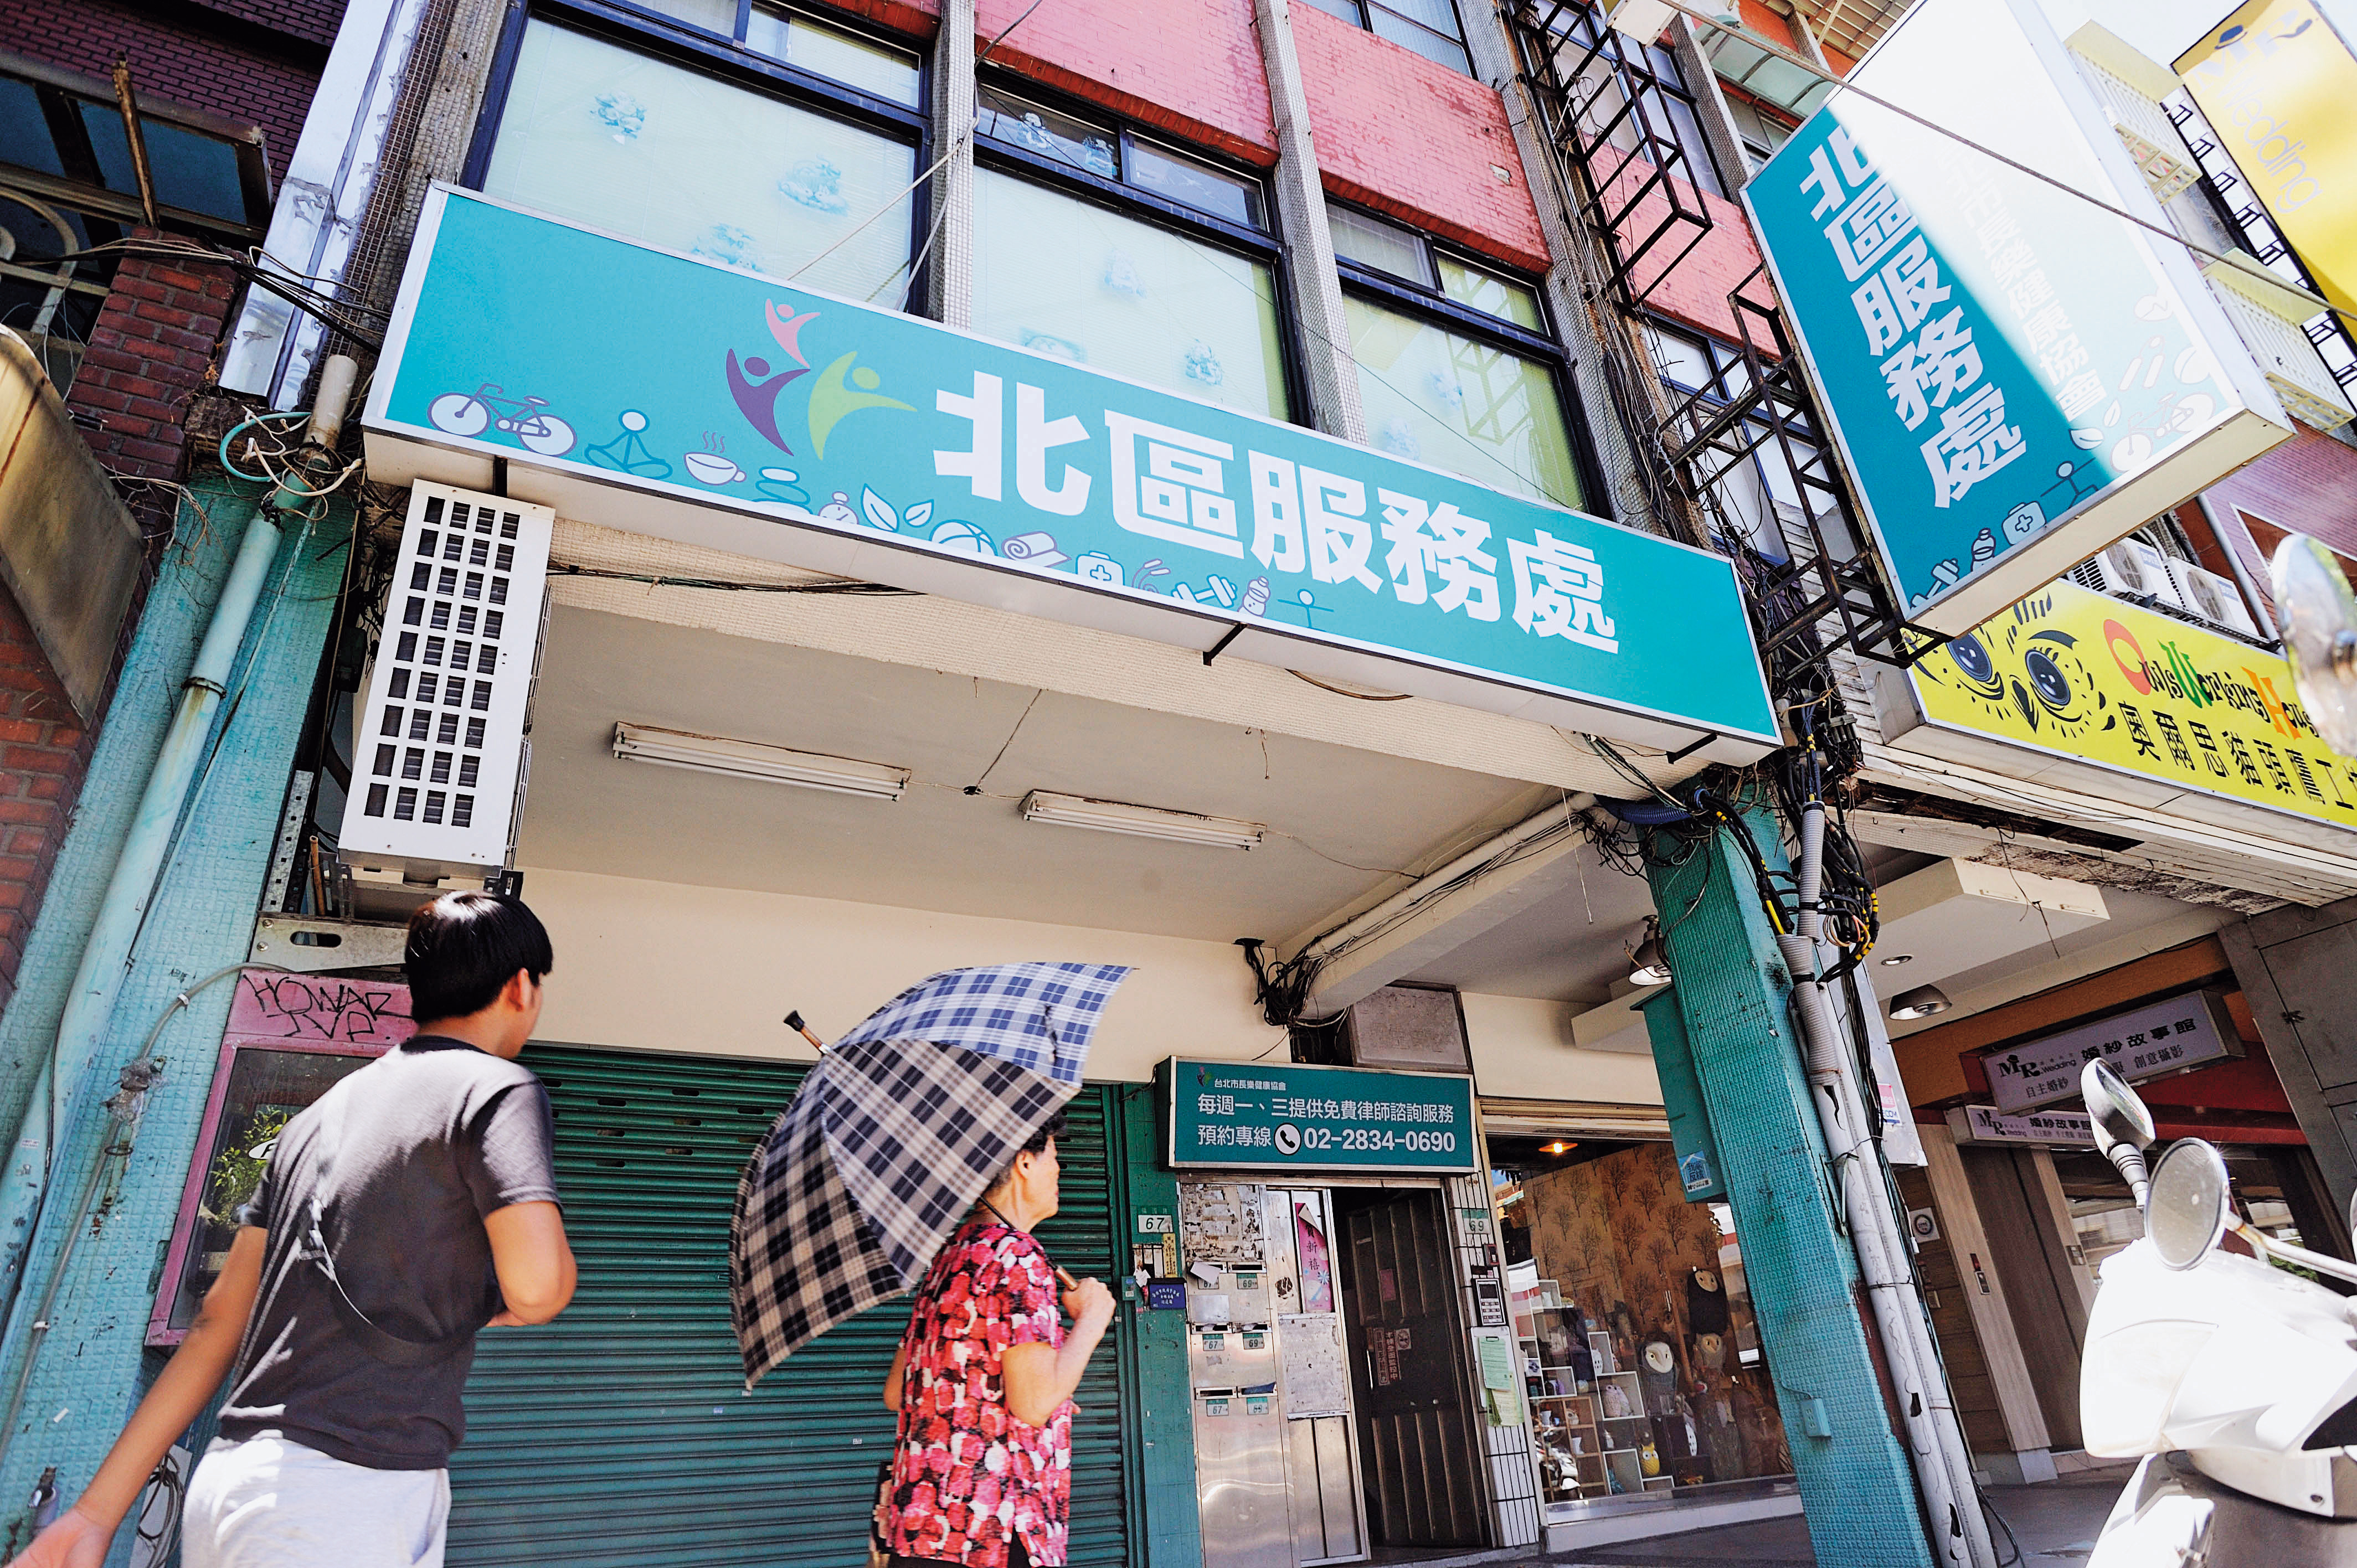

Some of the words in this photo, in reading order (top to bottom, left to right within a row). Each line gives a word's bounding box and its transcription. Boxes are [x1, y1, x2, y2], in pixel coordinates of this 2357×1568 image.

[2217, 64, 2323, 214] Wedding
[1799, 123, 2026, 508] 北區服務處
[933, 369, 1619, 654] 北區服務處
[2241, 666, 2320, 740] Hous
[2081, 1018, 2197, 1062] 婚紗故事館
[1214, 1079, 1286, 1091] 台北市長樂健康協會
[1197, 1093, 1454, 1123] 每週一、三提供免費律師諮詢服務
[1197, 1125, 1272, 1147] 預約專線
[1304, 1127, 1456, 1153] 02-2834-0690
[1145, 1218, 1165, 1230] 67
[1305, 1224, 1320, 1271] 賀新禧
[1243, 1280, 1252, 1288] 69
[1208, 1340, 1218, 1349] 67
[1249, 1339, 1258, 1348] 69
[1213, 1406, 1222, 1414] 67
